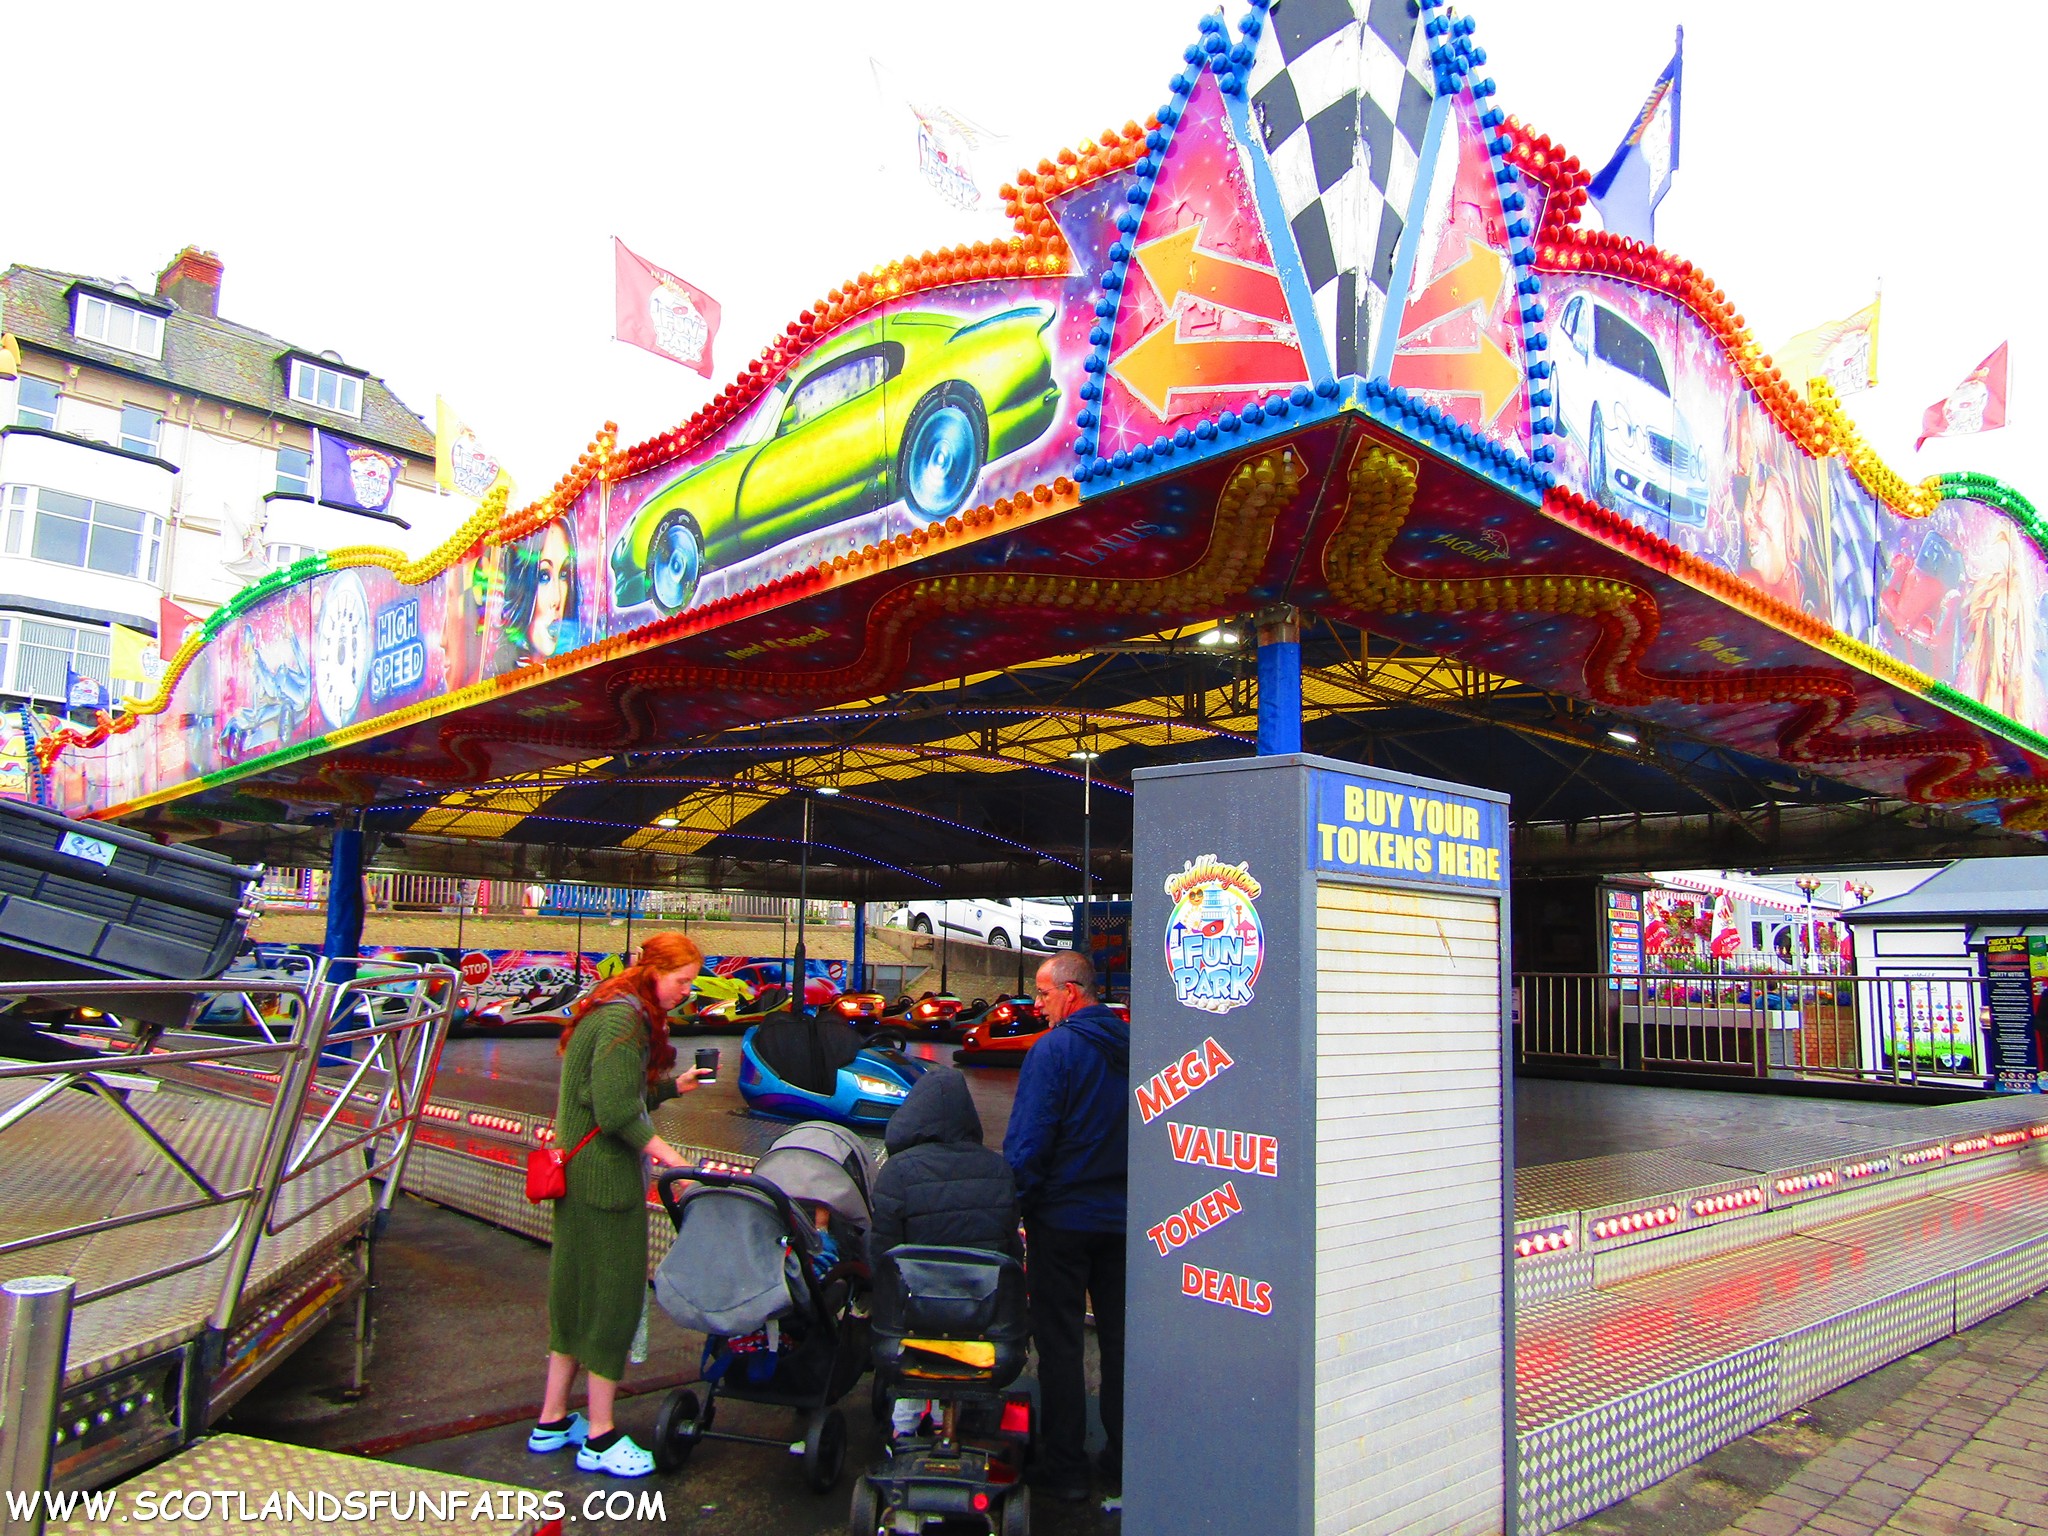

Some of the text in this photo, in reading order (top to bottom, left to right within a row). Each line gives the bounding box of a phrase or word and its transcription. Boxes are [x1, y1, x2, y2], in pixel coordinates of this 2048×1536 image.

[655, 325, 704, 362] PARK
[659, 307, 701, 340] FUN
[1428, 533, 1496, 562] JAGUAR
[377, 600, 418, 651] HIGH
[371, 642, 425, 694] SPEED
[1344, 785, 1480, 841] BUY YOUR
[1317, 822, 1501, 882] TOKENS HERE
[1166, 856, 1262, 903] Bridlington
[462, 962, 489, 977] STOP
[1182, 934, 1244, 969] FUN
[1173, 965, 1254, 1002] PARK
[1135, 1036, 1235, 1125] MEGA
[1166, 1121, 1279, 1177] VALUE
[1147, 1180, 1243, 1257] TOKEN
[1182, 1262, 1274, 1316] DEALS
